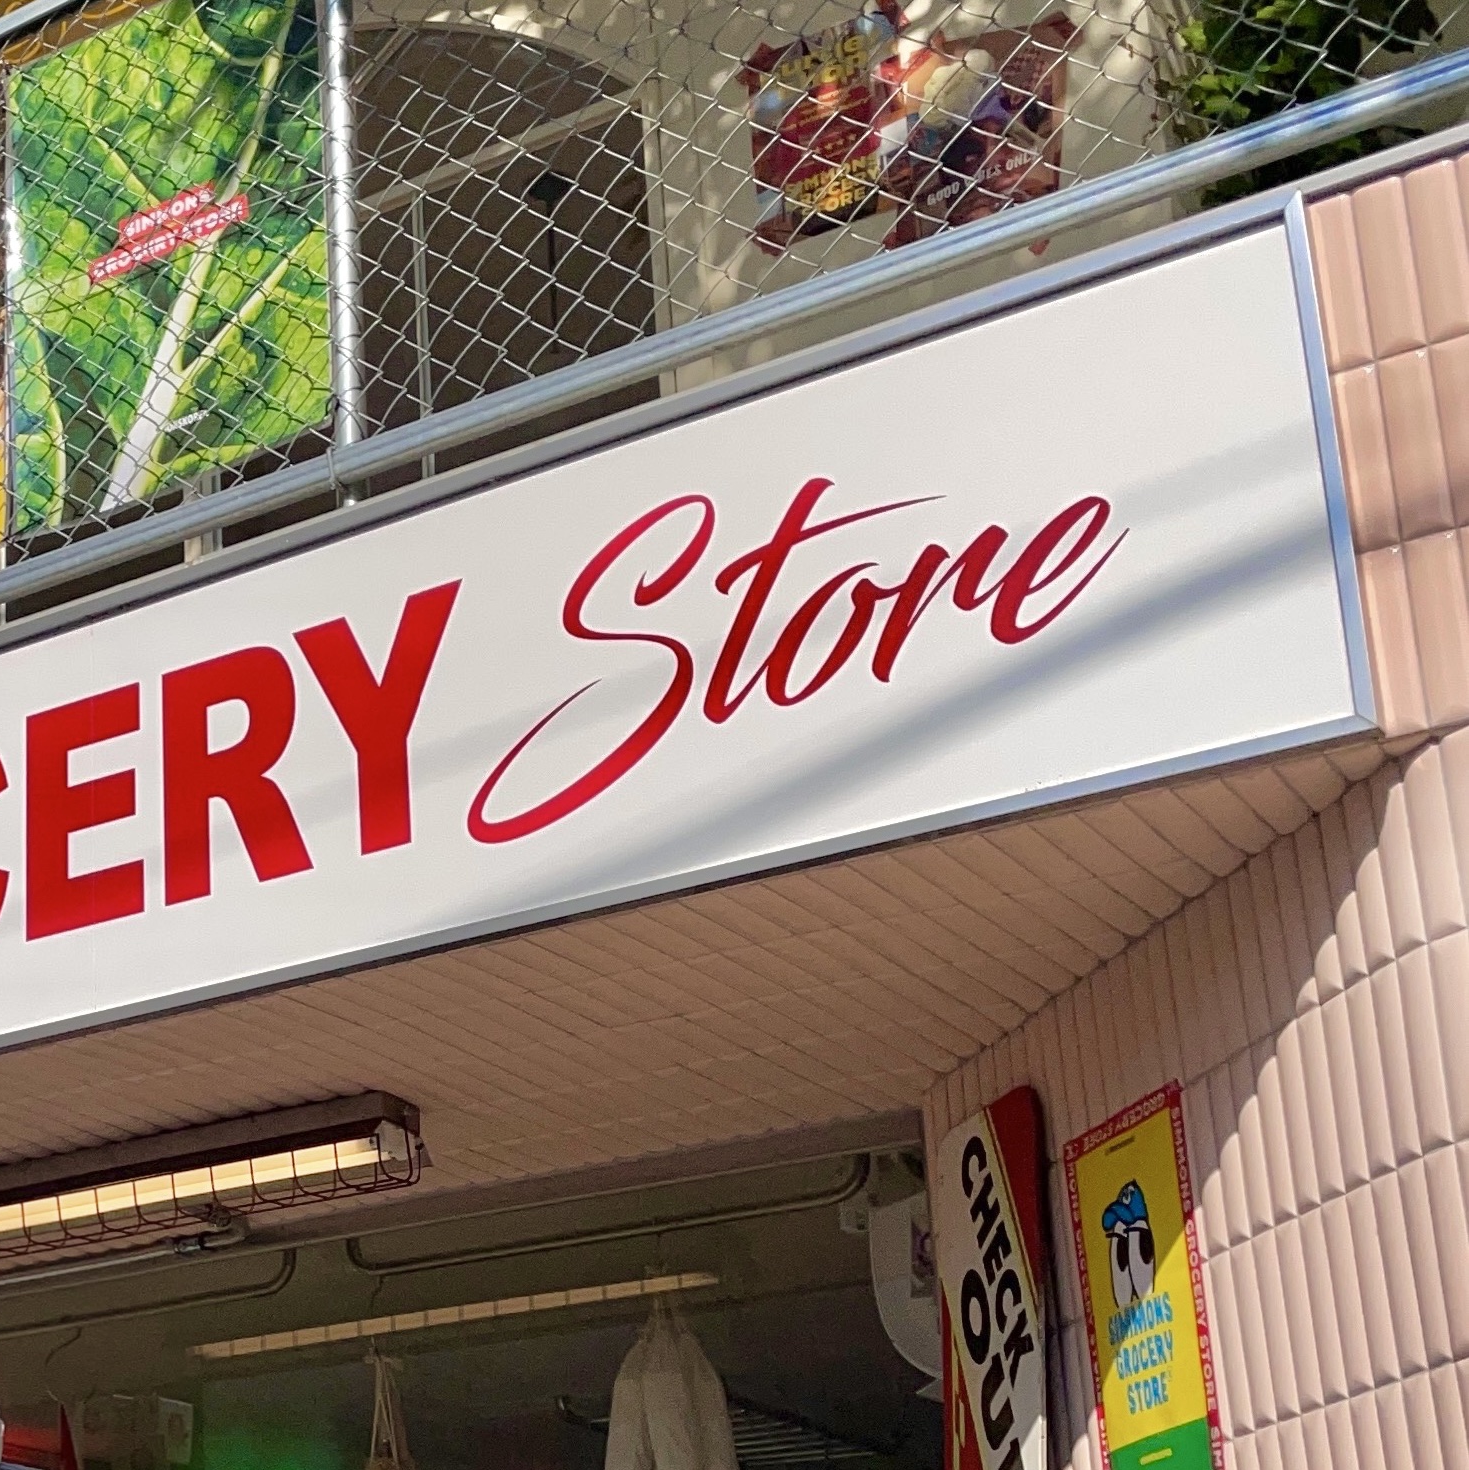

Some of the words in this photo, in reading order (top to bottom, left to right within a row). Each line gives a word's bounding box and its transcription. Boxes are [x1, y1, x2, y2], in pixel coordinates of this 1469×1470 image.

[964, 165, 1002, 187] VBES
[467, 477, 1131, 844] Store
[961, 1135, 1034, 1388] CHECK
[1108, 1291, 1173, 1346] SIMMONS
[1185, 1217, 1208, 1327] GROCERY
[1198, 1334, 1219, 1411] STORE
[1116, 1329, 1173, 1380] GROCERY
